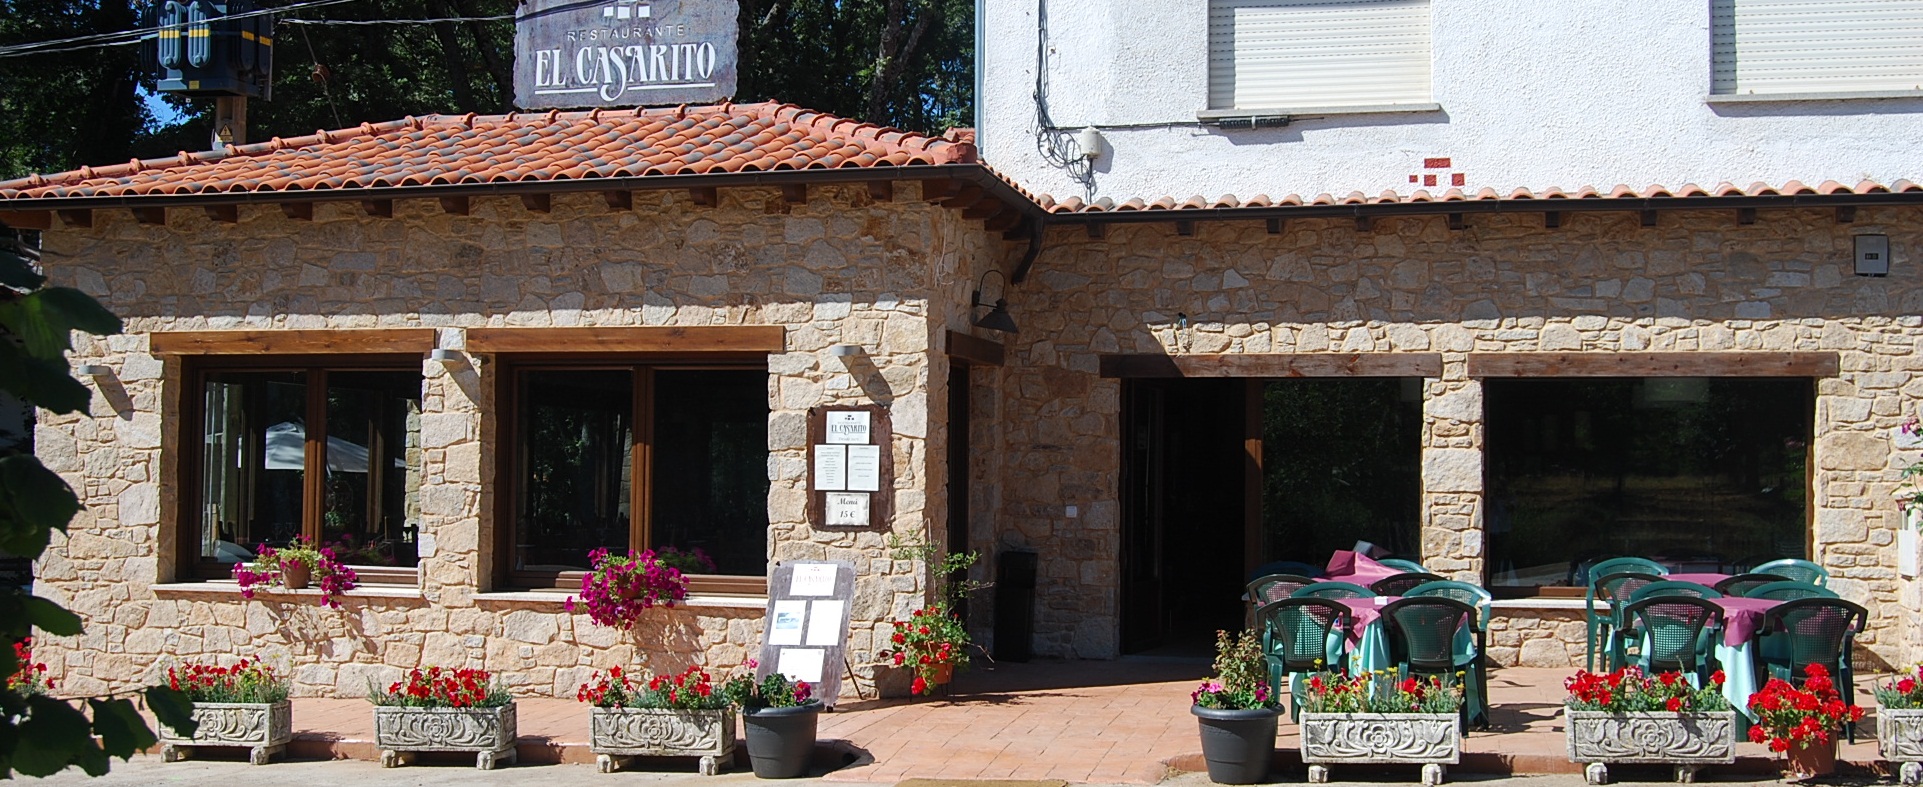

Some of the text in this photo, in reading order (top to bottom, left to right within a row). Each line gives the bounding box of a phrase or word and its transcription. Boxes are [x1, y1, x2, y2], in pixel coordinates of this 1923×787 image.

[566, 24, 685, 42] RESTAURANTE
[535, 42, 716, 101] EL CASARITO
[840, 510, 848, 518] 15
